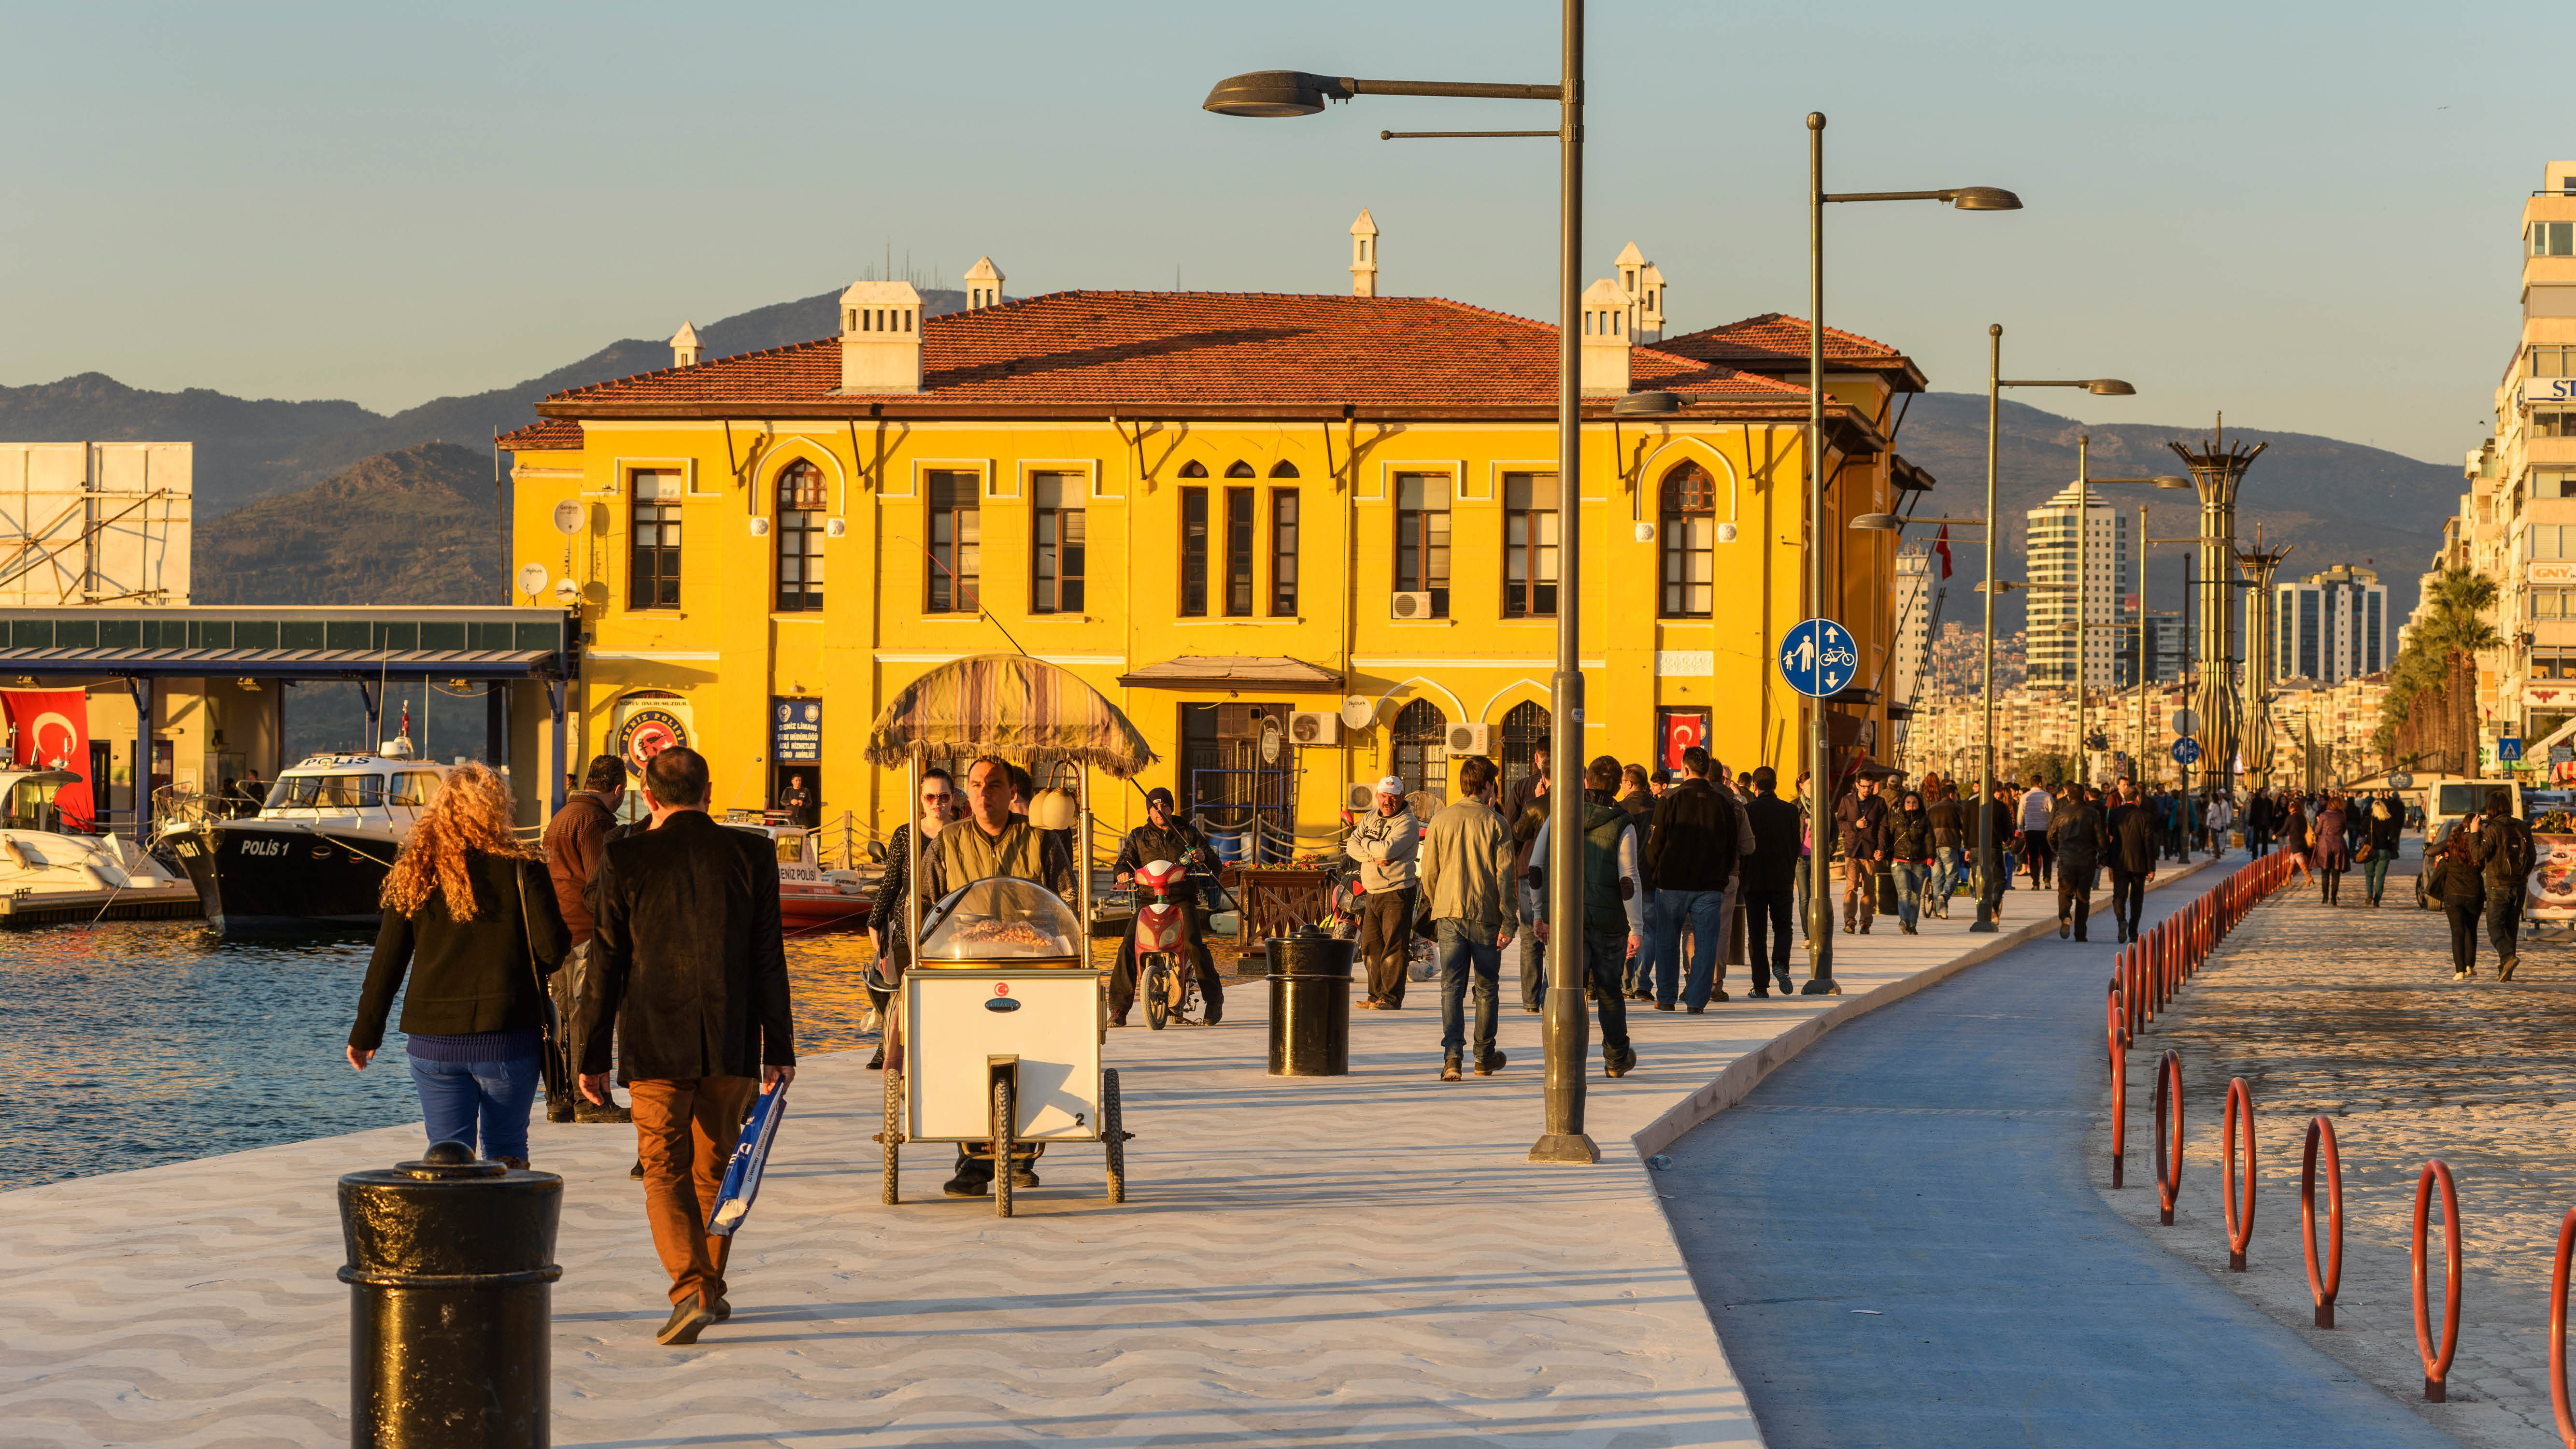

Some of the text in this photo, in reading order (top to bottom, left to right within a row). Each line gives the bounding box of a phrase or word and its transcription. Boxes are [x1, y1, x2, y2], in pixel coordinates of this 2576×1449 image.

[2535, 568, 2569, 578] GNY
[622, 714, 648, 741] DENİZ
[779, 721, 818, 731] DENİZ LİMANI
[777, 734, 789, 742] ŞUBE
[791, 741, 816, 750] HİZMETLER
[780, 750, 793, 758] BÜRO
[175, 839, 201, 858] POLİS 1
[241, 838, 290, 856] POLİS 1
[780, 867, 816, 881] ENİZ POLİSİ
[1075, 1113, 1085, 1126] 2
